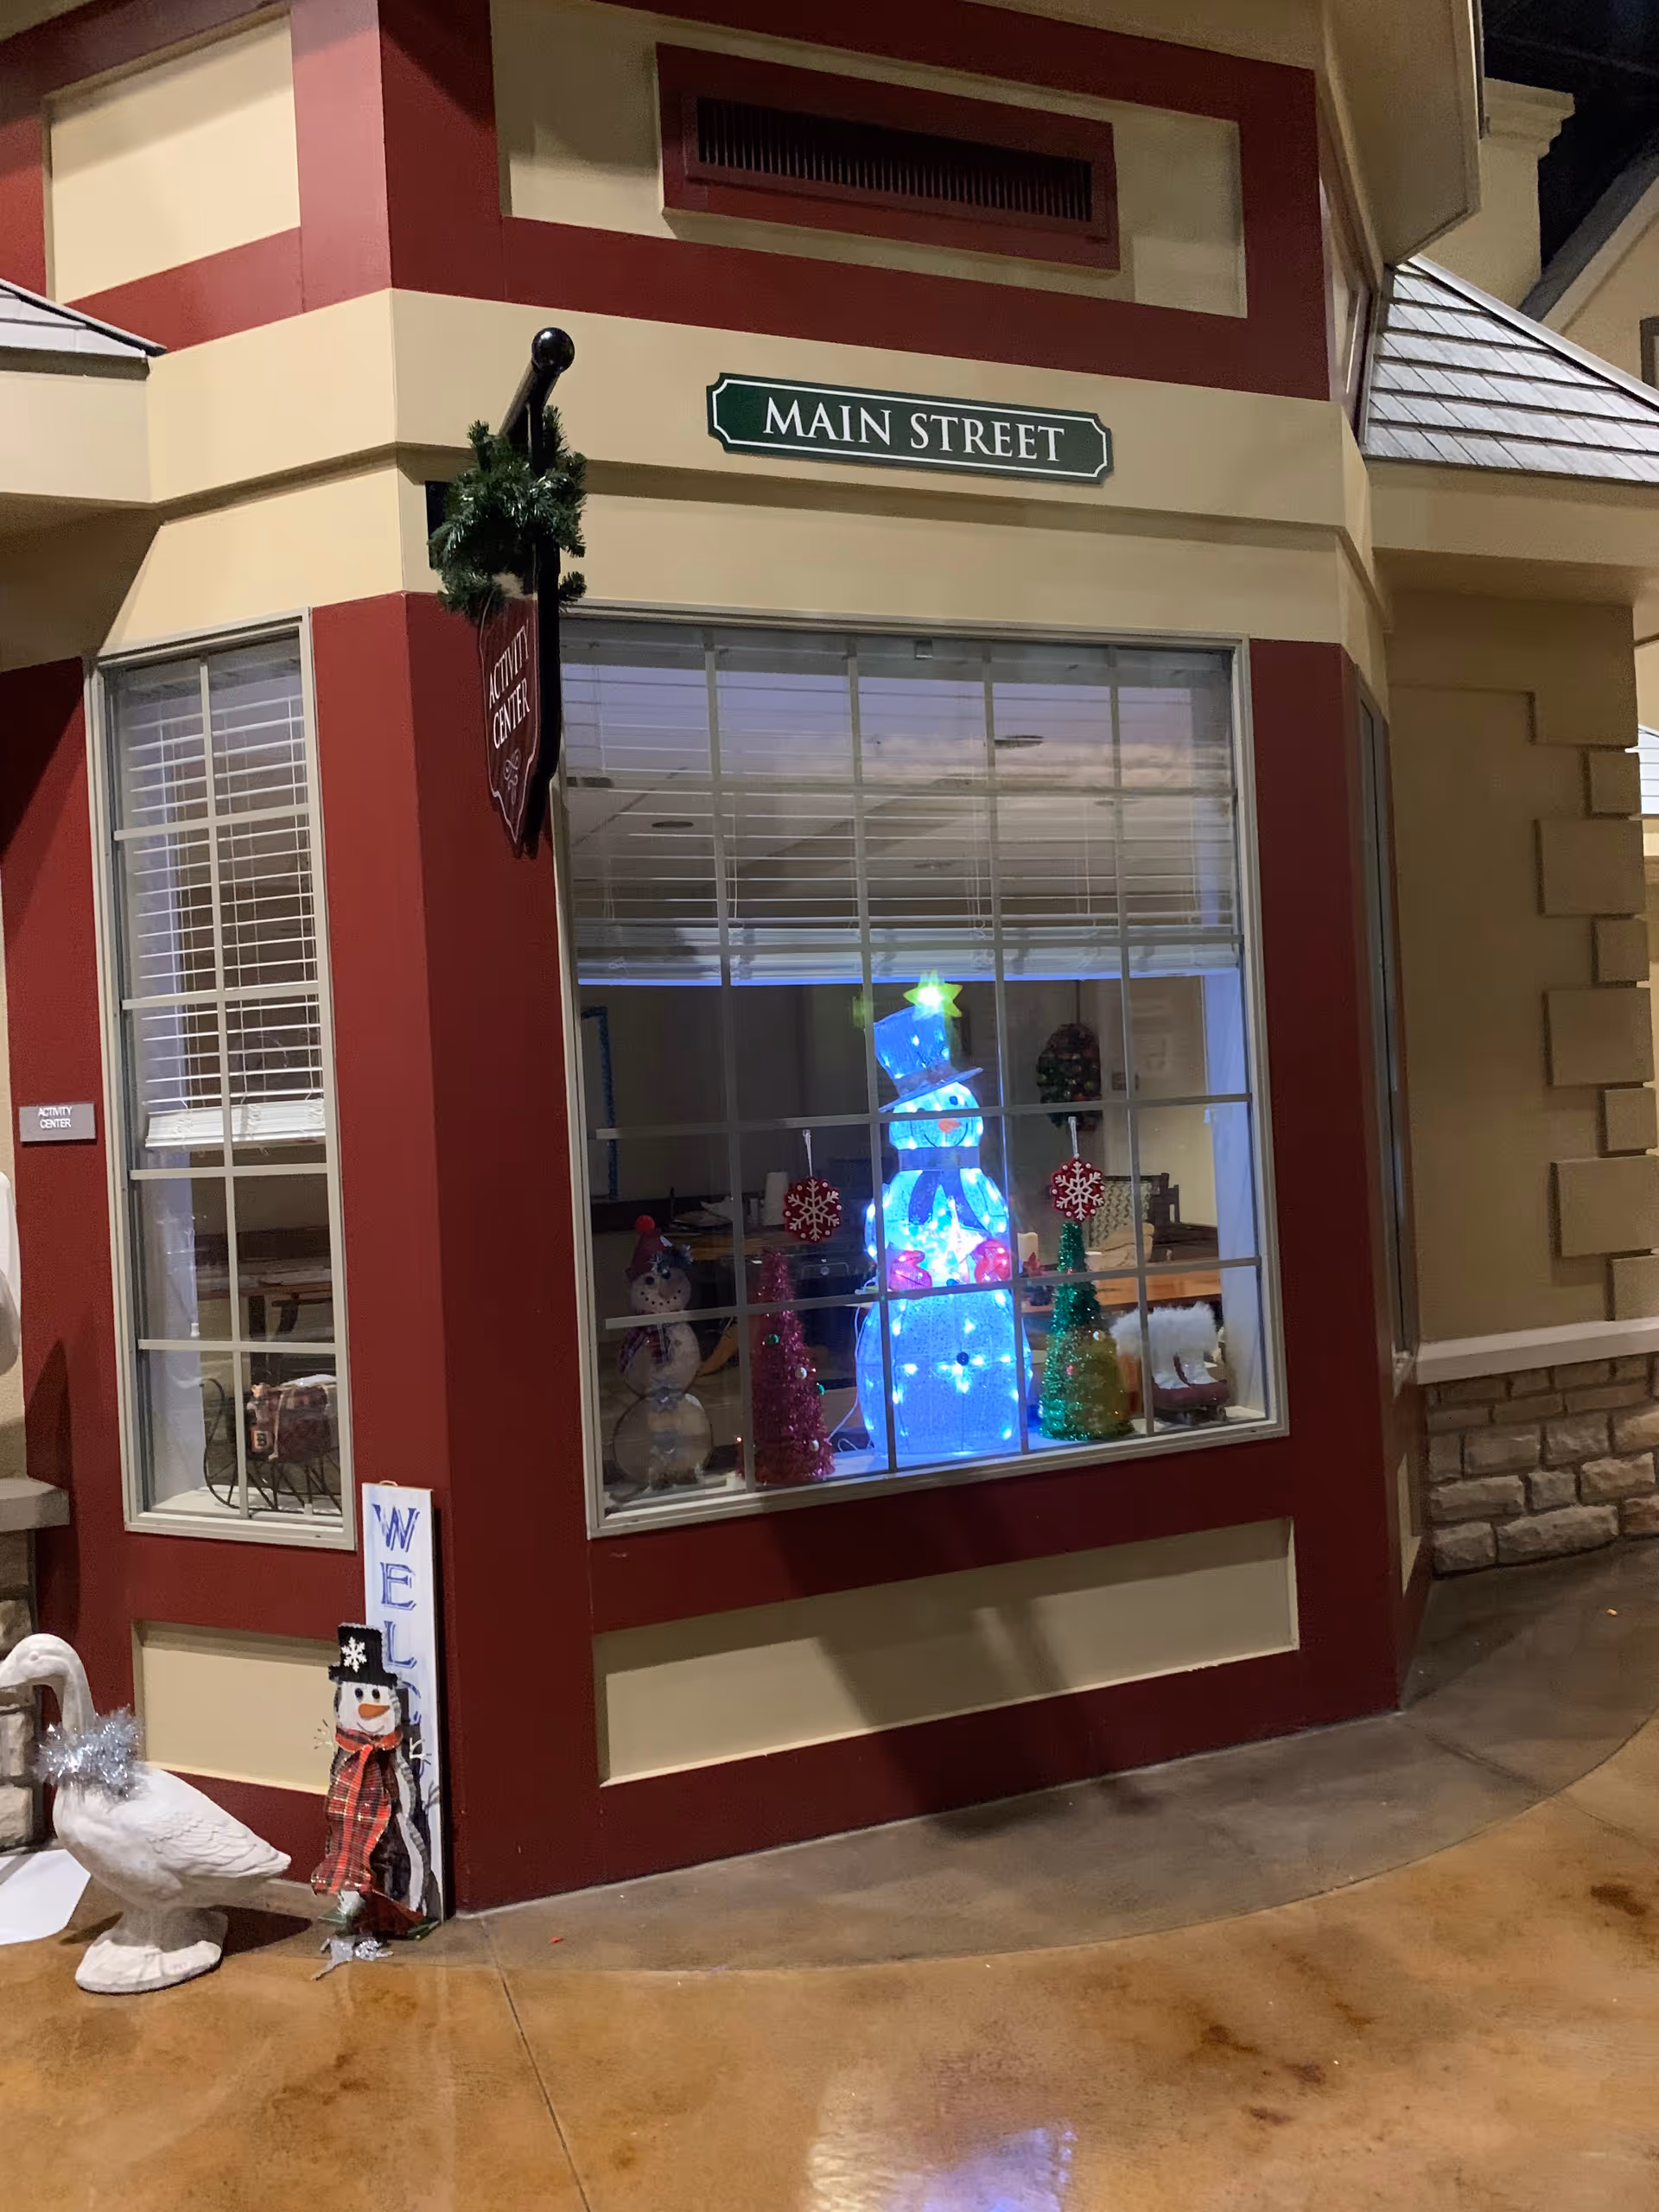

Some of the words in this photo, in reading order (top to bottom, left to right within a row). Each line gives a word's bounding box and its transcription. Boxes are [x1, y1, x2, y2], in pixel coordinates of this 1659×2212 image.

[763, 397, 892, 445] MAIN
[911, 413, 1065, 461] STREET
[489, 619, 529, 709] ACTIVITY
[493, 677, 531, 749] CENTER
[38, 1106, 73, 1116] ACTIVITY
[40, 1118, 71, 1129] CENTER
